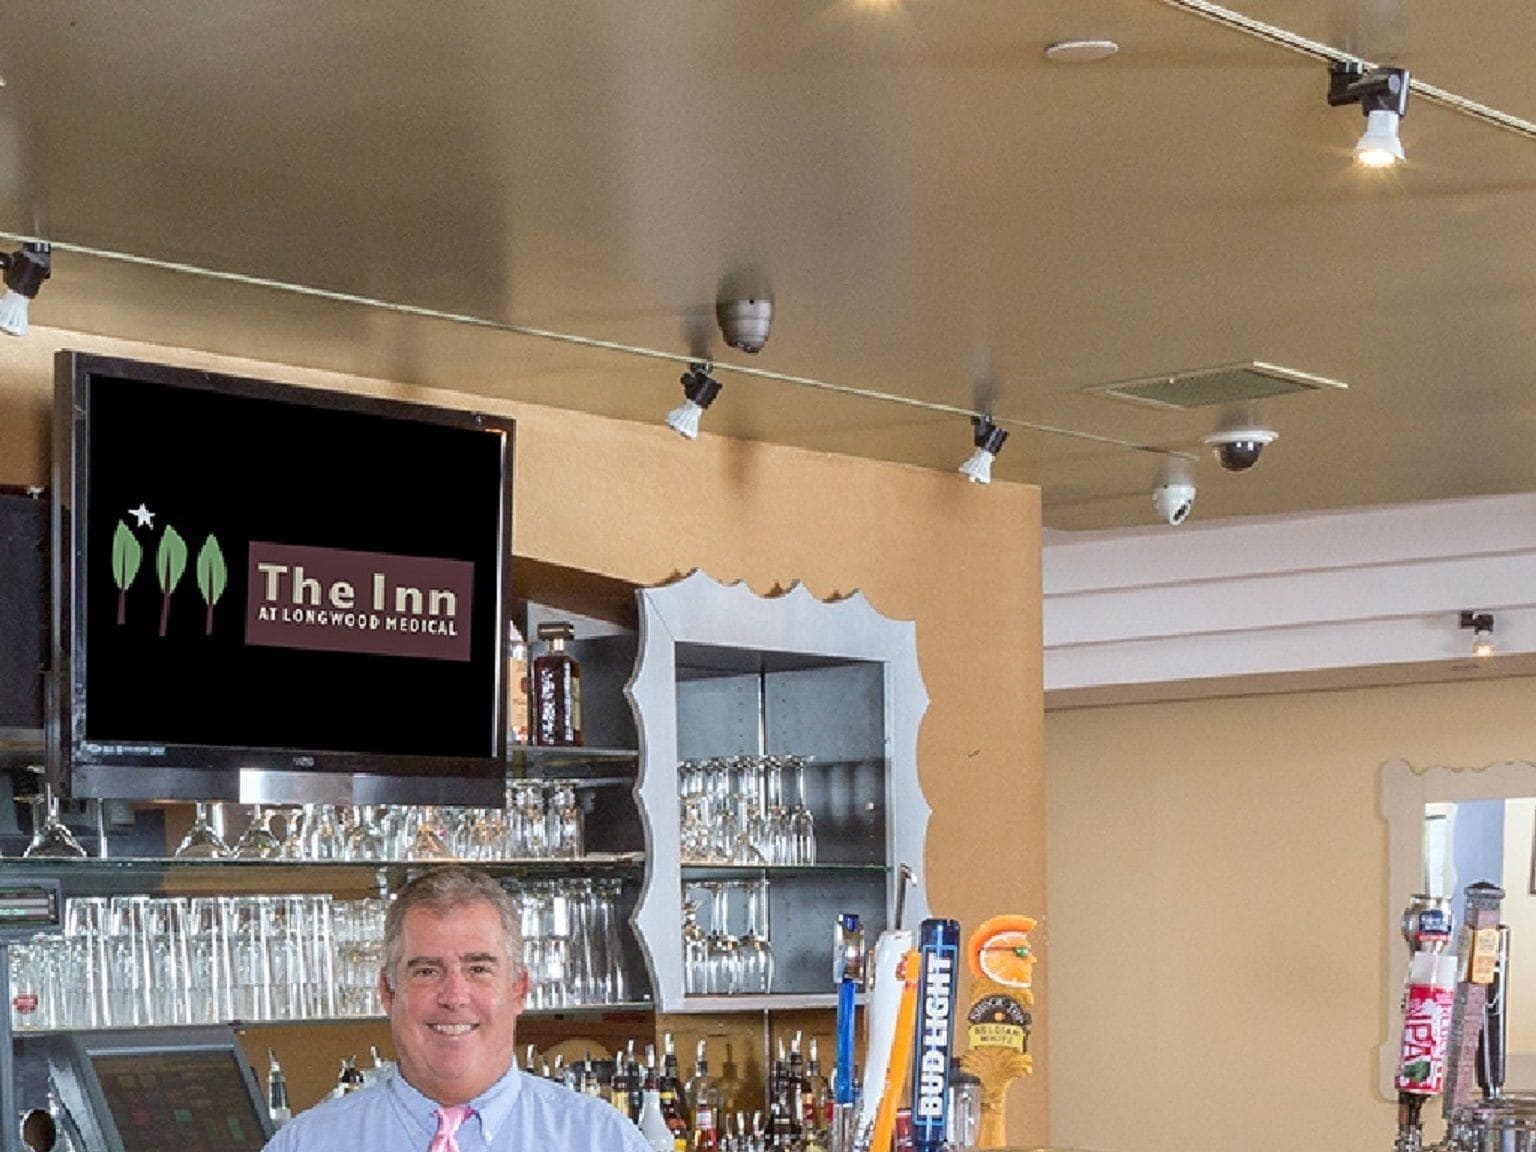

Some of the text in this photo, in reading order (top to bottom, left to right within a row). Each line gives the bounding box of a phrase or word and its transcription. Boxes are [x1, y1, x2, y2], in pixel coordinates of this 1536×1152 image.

[258, 562, 457, 617] The Inn
[259, 607, 458, 636] AT LONGWOOD MEDICAL
[918, 951, 953, 1116] BUD LIGHT
